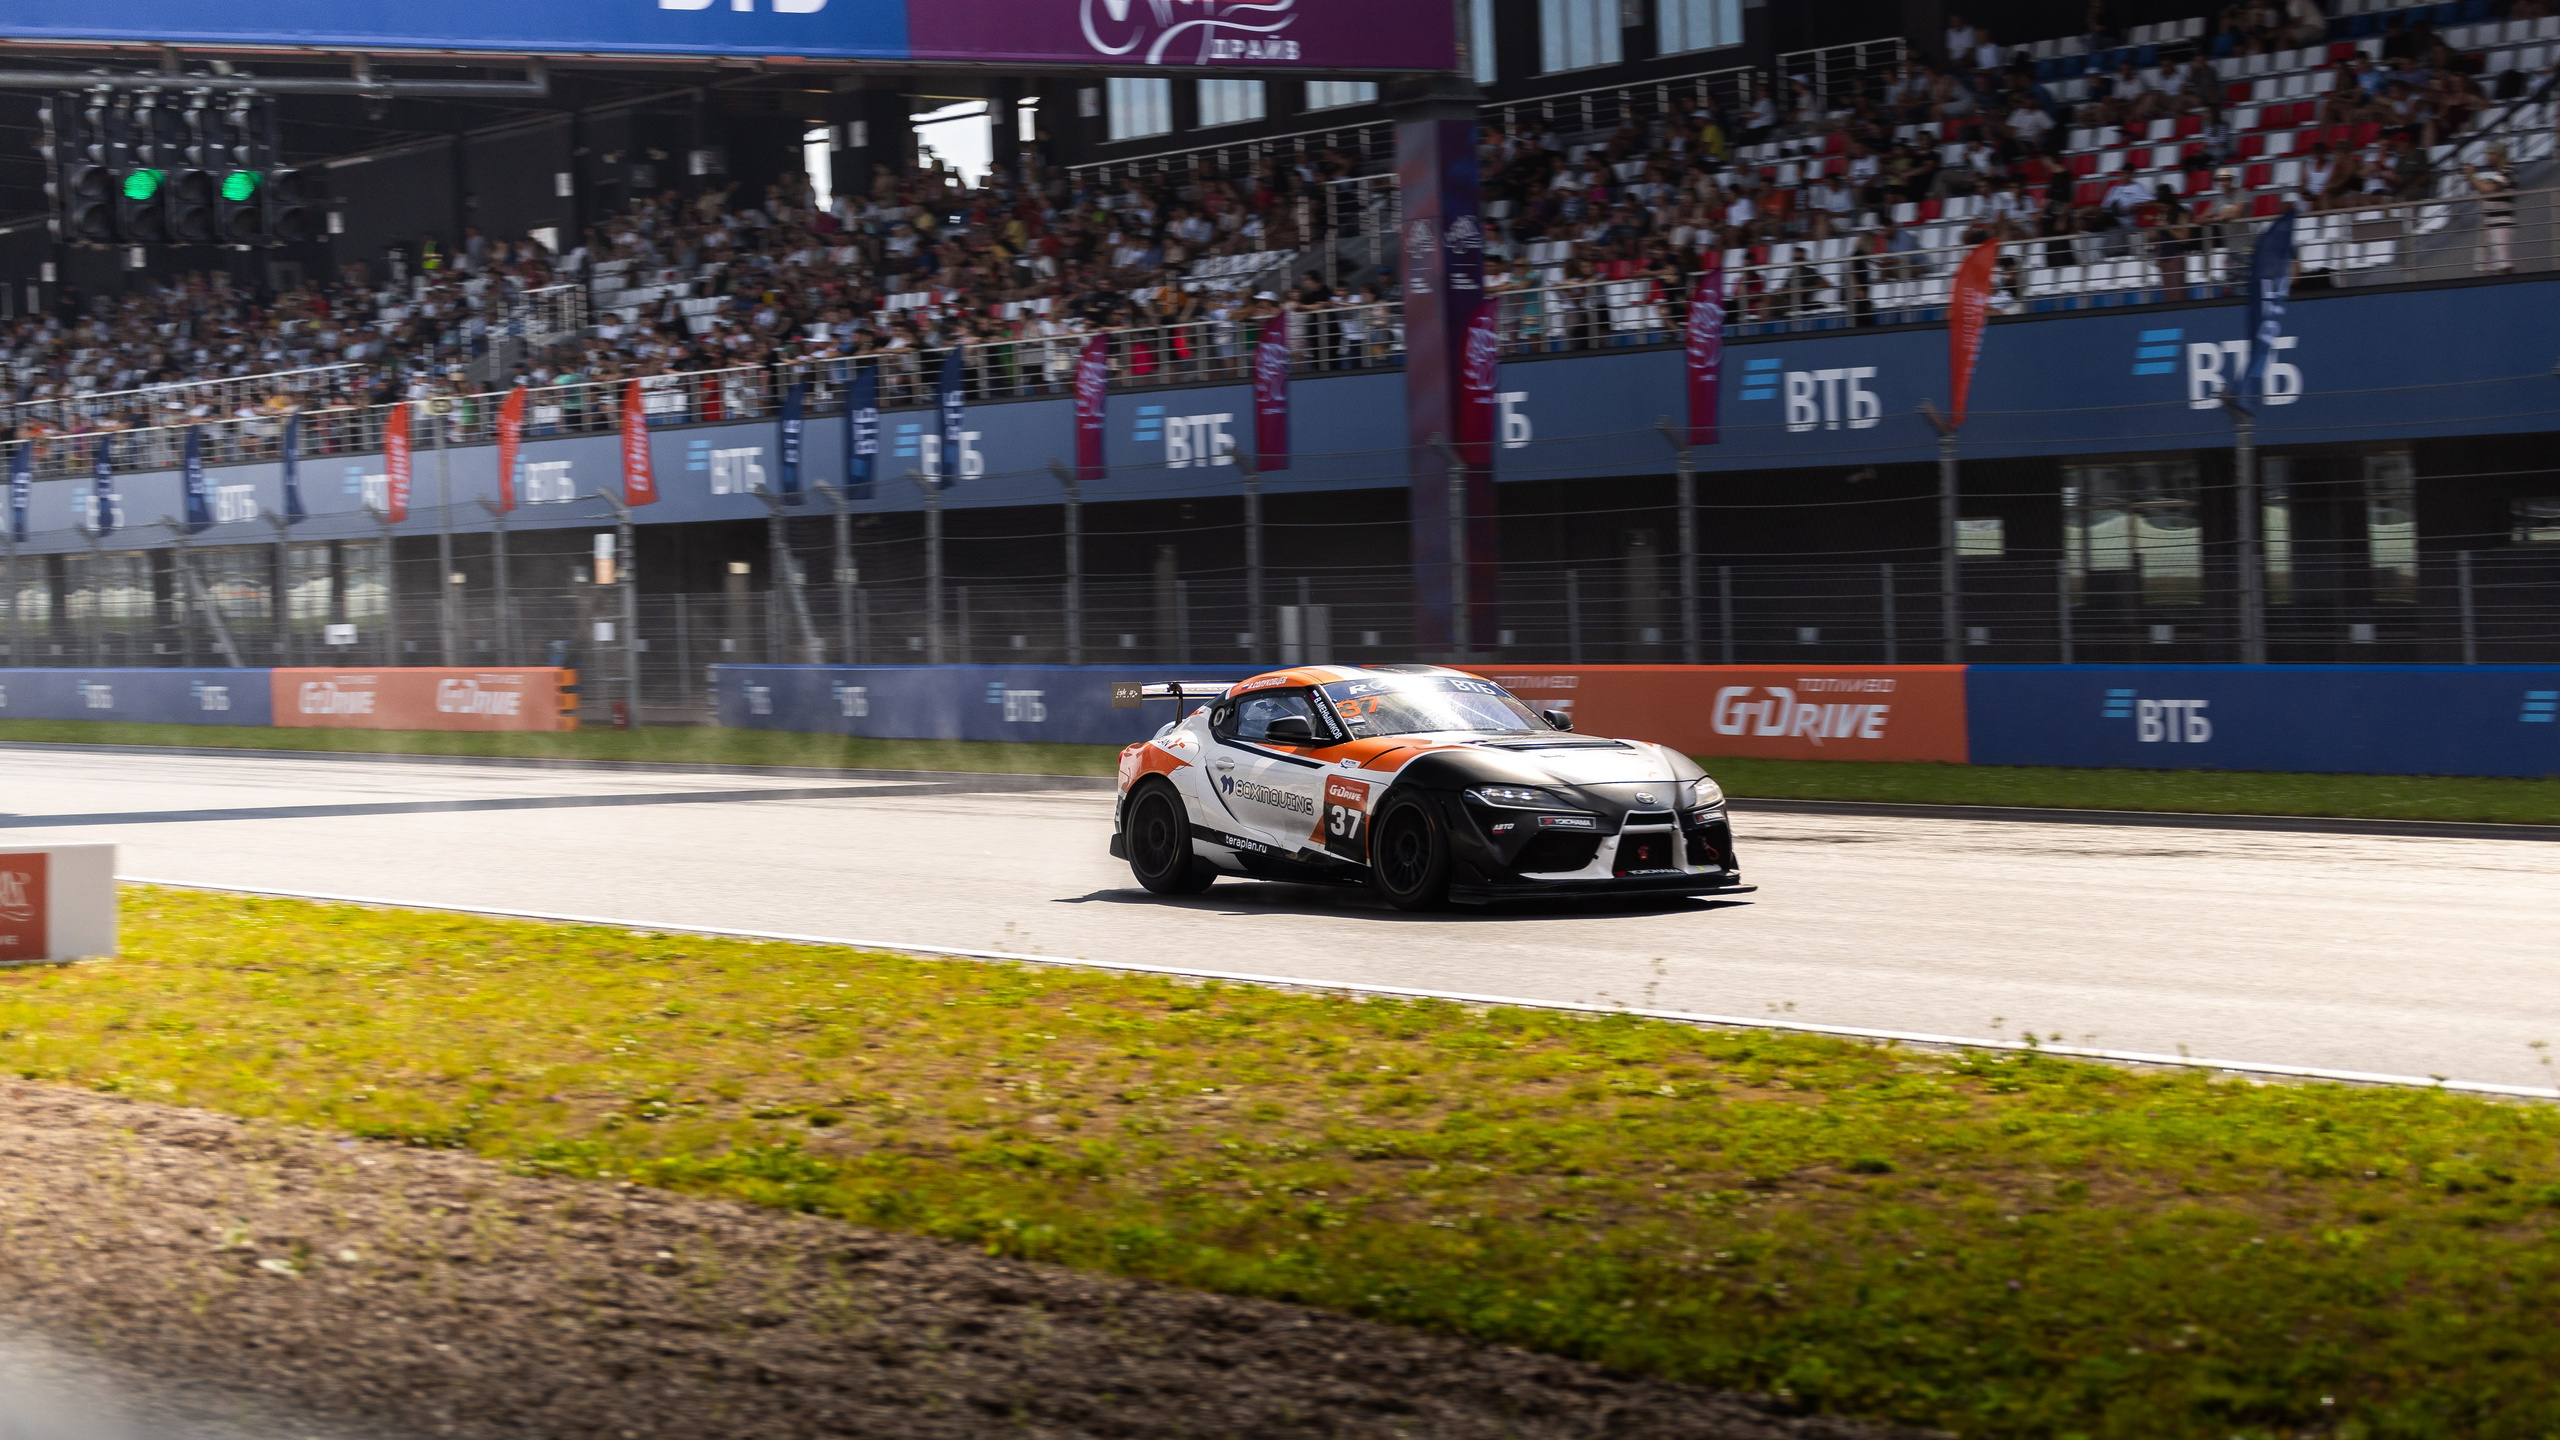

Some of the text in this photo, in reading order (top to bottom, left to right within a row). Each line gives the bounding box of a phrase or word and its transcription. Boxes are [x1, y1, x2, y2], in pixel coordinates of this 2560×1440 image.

[1784, 366, 1882, 432] ВТБ
[921, 431, 984, 482] ВБ
[1165, 413, 1235, 468] ВТБ
[710, 446, 766, 495] ВТБ
[1337, 696, 1379, 718] 37
[1450, 679, 1496, 696] ВТБ
[1313, 696, 1343, 740] В.МЕНЬШИКОВ
[2136, 698, 2213, 743] ВТБ
[1235, 780, 1315, 816] BOXMOVING
[1330, 804, 1362, 839] 37
[1554, 818, 1592, 826] YOKOHAMA
[1225, 834, 1267, 854] teraplan.ru
